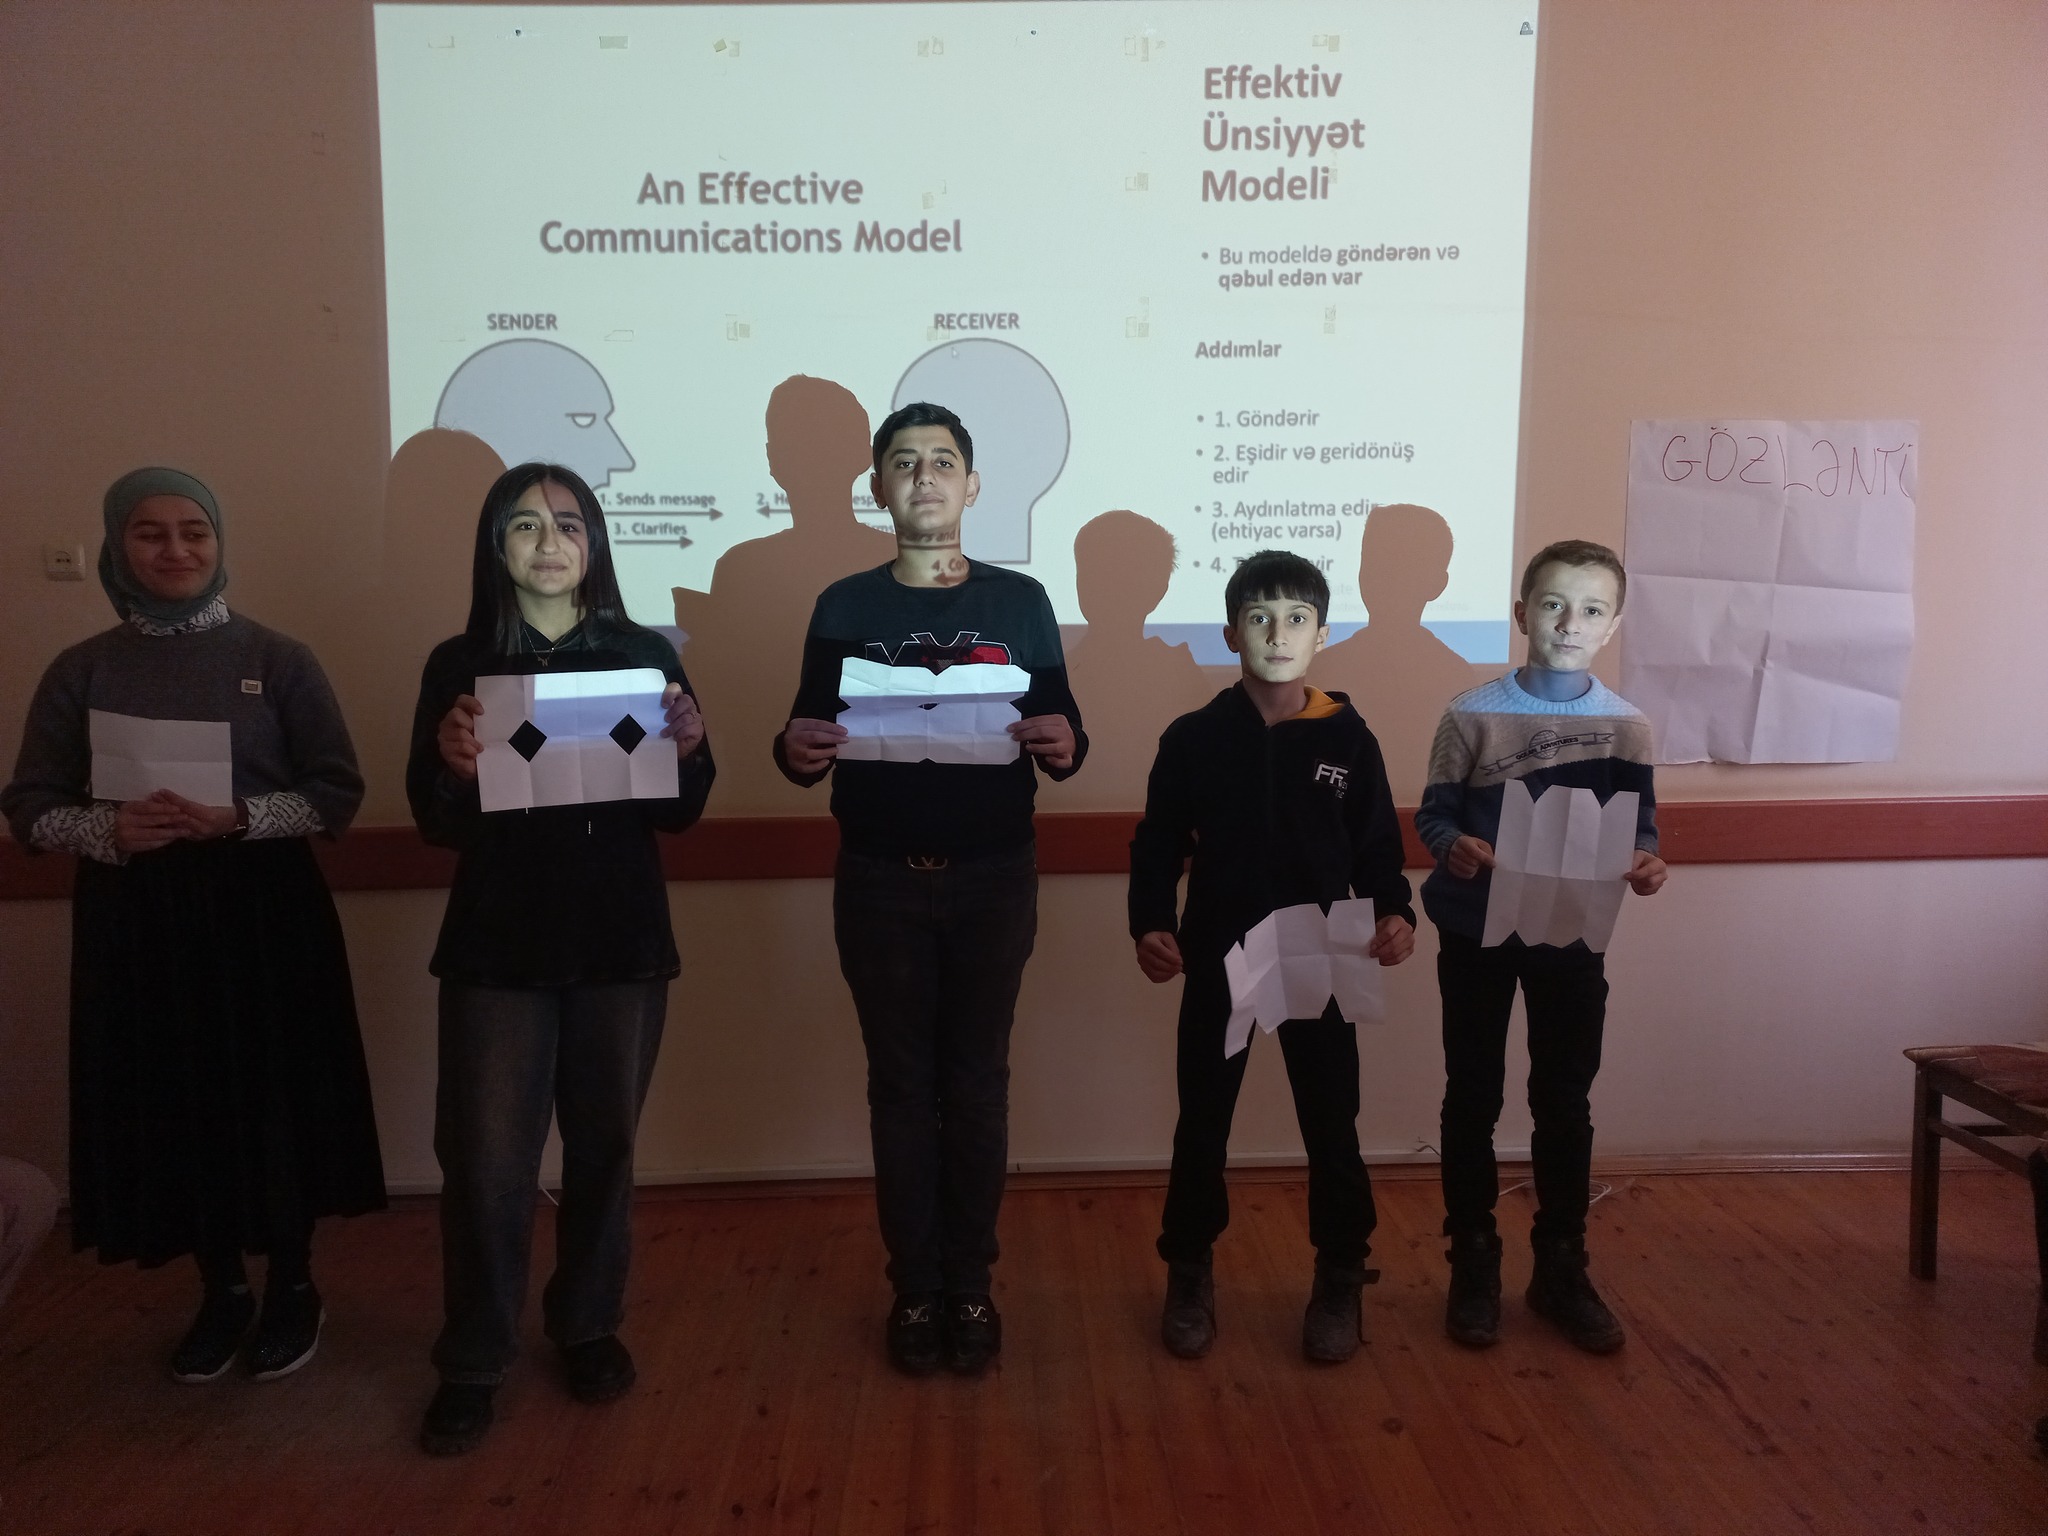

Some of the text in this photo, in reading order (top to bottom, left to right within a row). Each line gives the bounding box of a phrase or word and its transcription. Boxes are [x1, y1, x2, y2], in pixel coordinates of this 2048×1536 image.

[1204, 64, 1343, 100] Effektiv
[1203, 110, 1366, 158] Ünsiyyət
[637, 171, 864, 205] An Effective
[1201, 166, 1330, 202] Modeli
[539, 220, 963, 254] Communications Model
[1219, 243, 1460, 267] Bu modeldə göndərən və
[1218, 268, 1363, 292] qəbul edən var
[487, 314, 558, 331] SENDER
[934, 313, 1020, 330] RECEIVER
[1195, 340, 1282, 359] Addımlar
[1215, 408, 1320, 428] 1. Göndərir
[1213, 441, 1415, 466] 2. Eşidir və geridönüş
[1212, 465, 1249, 484] edir
[616, 493, 656, 506] Sends
[660, 495, 716, 509] message
[756, 493, 769, 507] 2.
[1212, 501, 1229, 518] 3.
[1233, 501, 1336, 522] Aydınlatma
[614, 522, 688, 536] 3. Clarifies
[1211, 520, 1342, 543] (ehtiyac varsa)
[1210, 556, 1227, 574] 4.
